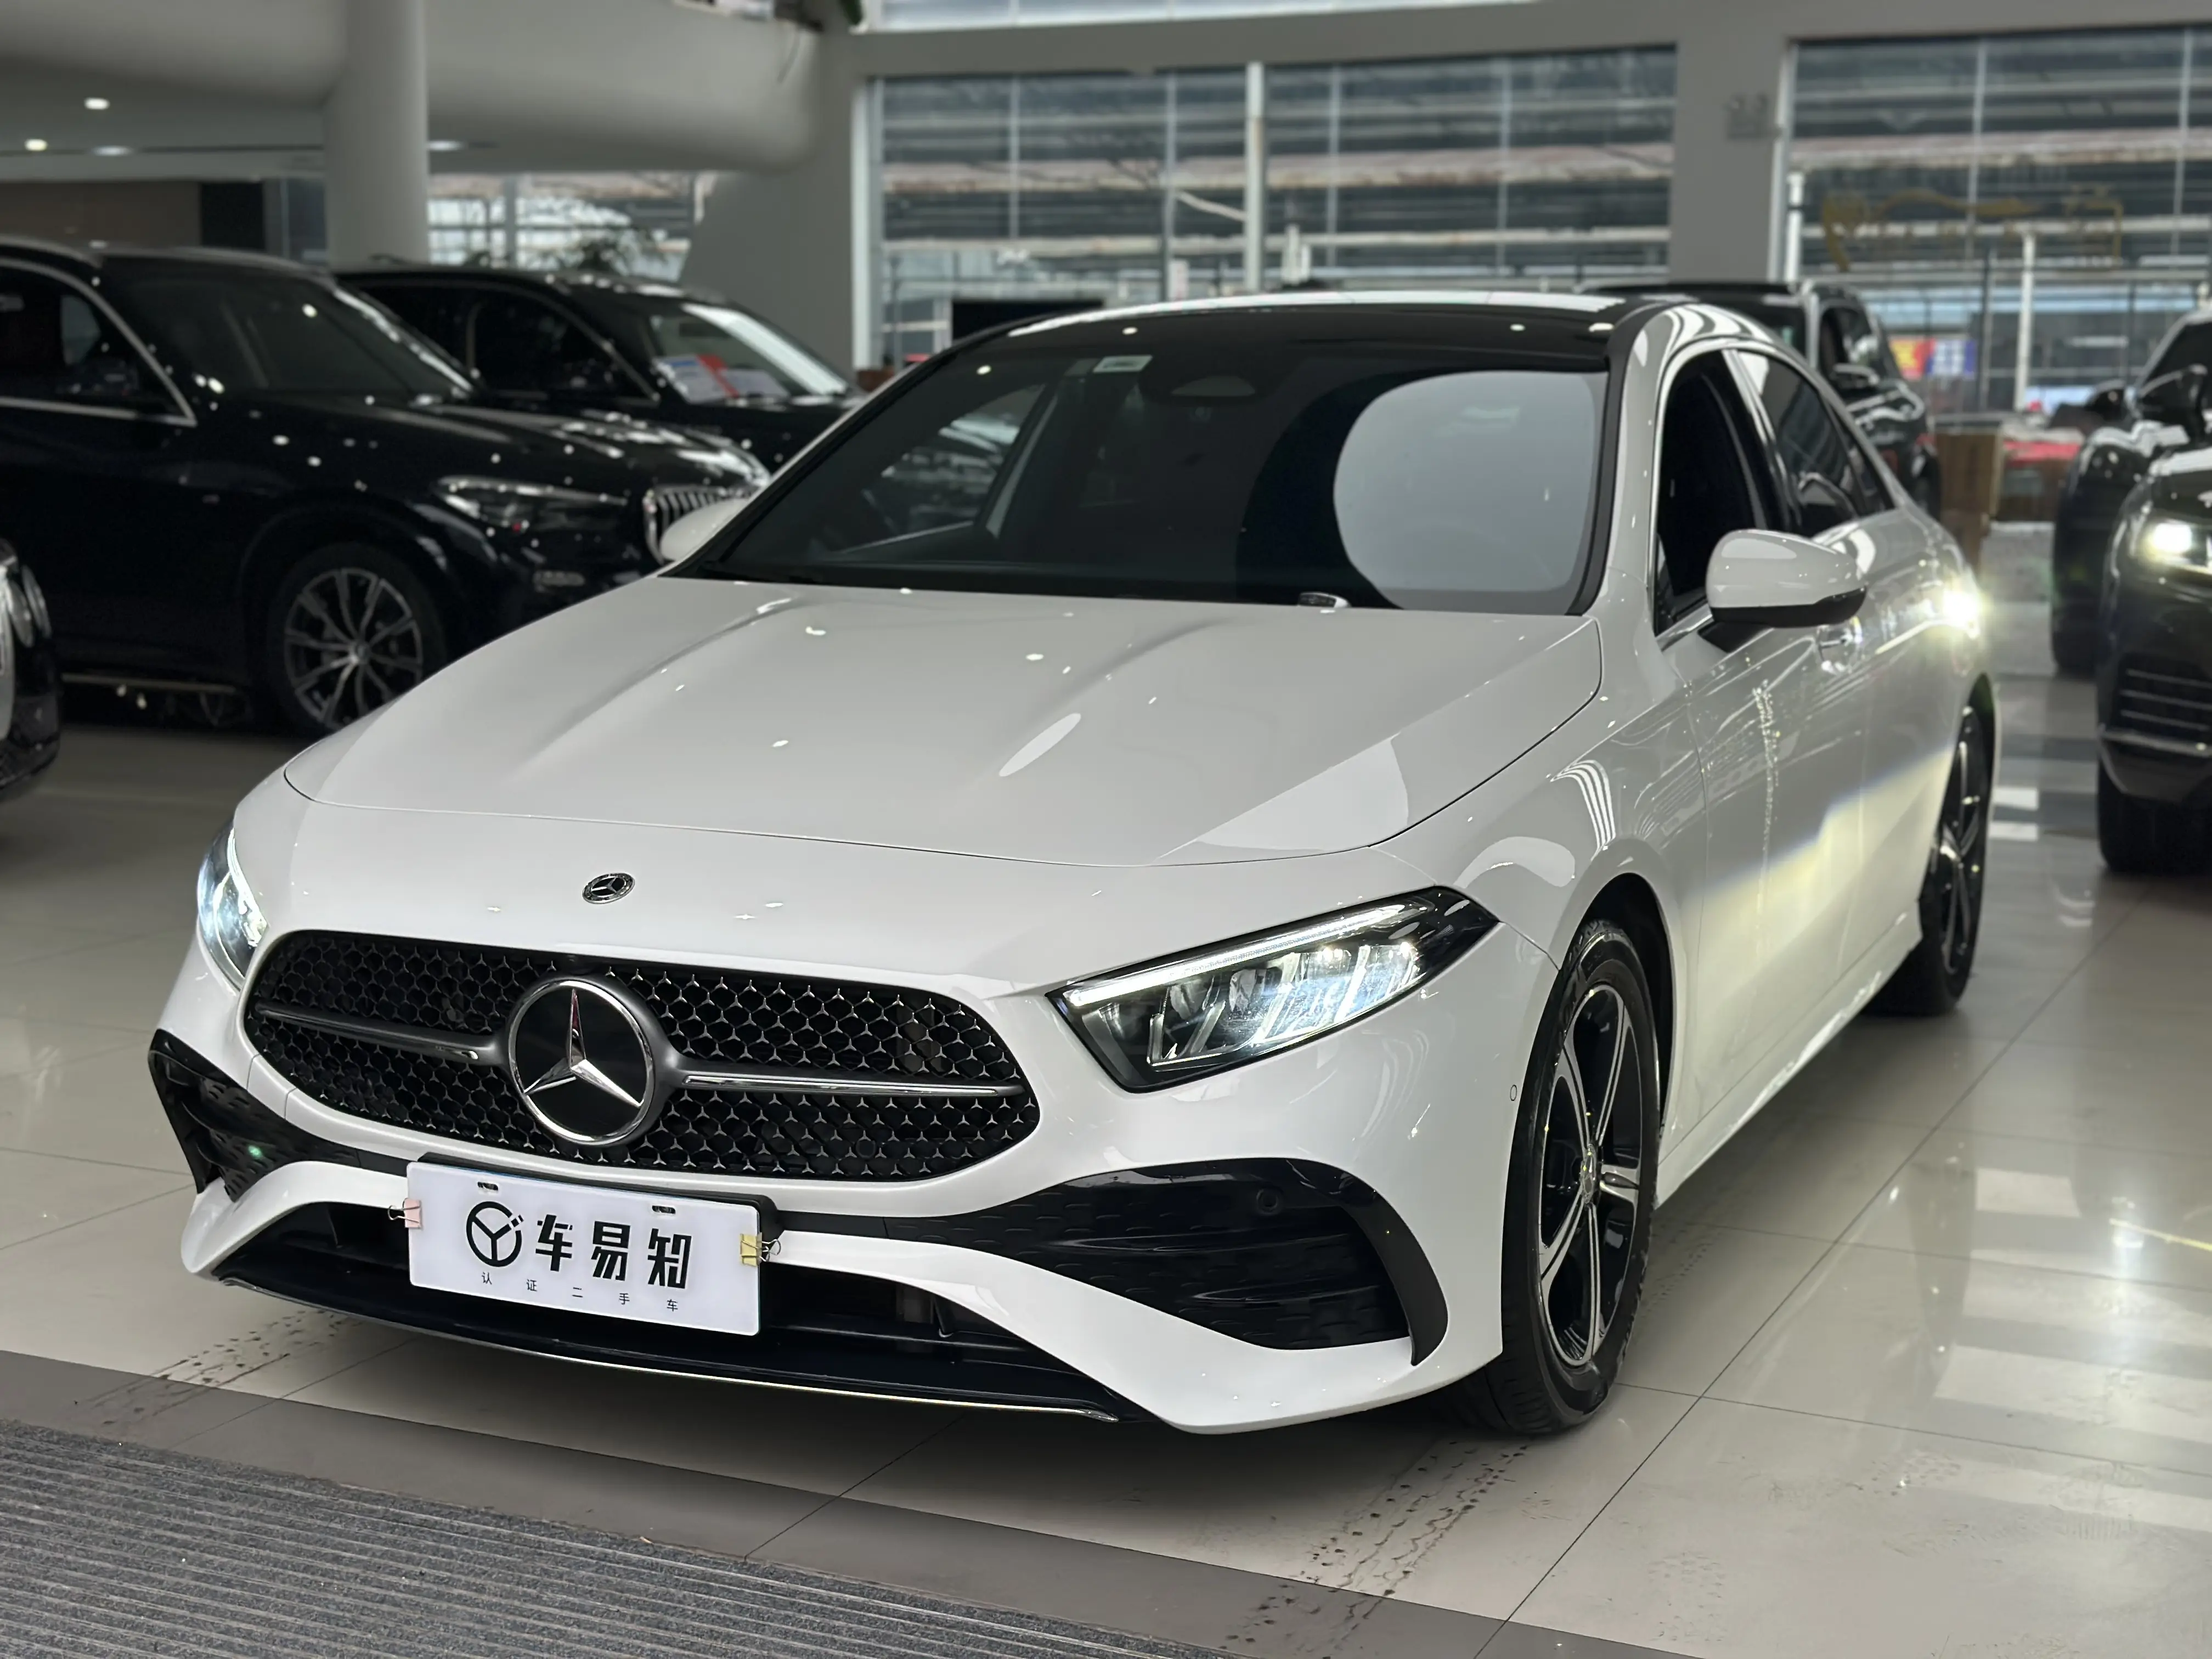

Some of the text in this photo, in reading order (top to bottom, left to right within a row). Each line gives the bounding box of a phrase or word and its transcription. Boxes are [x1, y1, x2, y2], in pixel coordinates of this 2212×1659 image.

[535, 1214, 692, 1289] 车易知
[481, 1272, 678, 1312] 认证二手车
